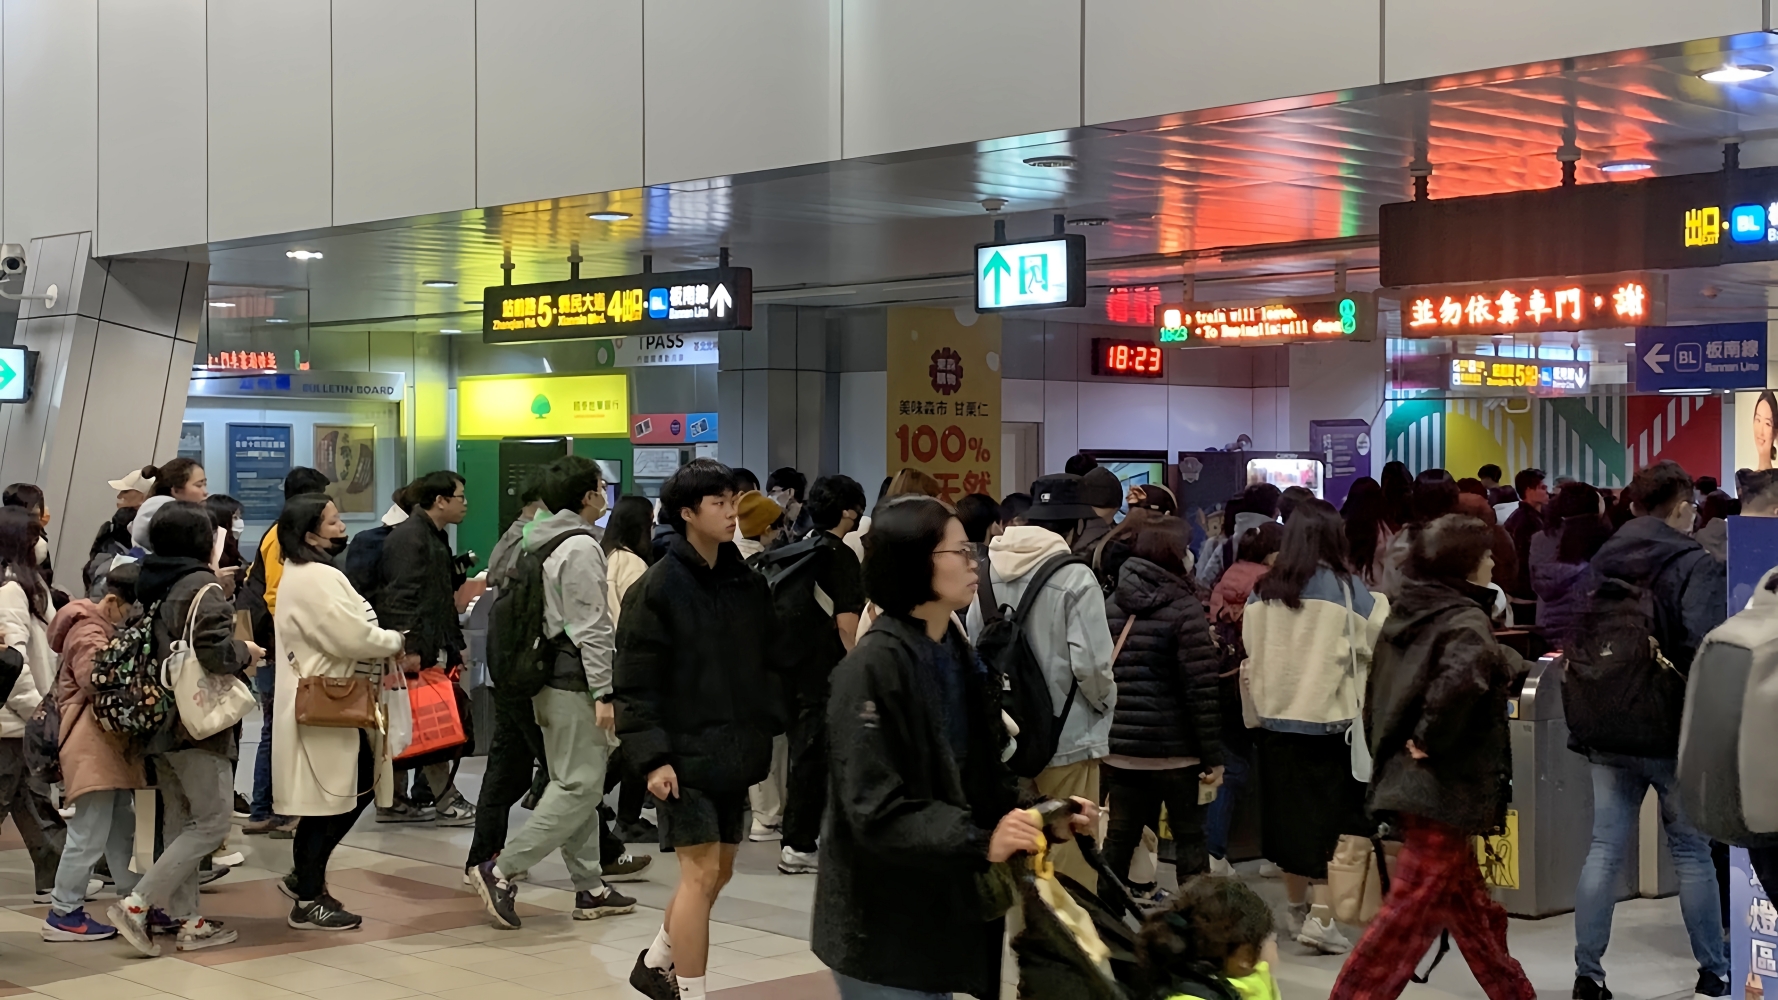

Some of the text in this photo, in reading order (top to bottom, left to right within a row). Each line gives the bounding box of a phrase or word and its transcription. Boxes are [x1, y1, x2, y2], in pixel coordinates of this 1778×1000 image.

[1737, 215, 1760, 232] BL
[537, 295, 552, 327] 5
[607, 290, 622, 322] 4
[1109, 345, 1161, 371] 18:23
[1679, 350, 1697, 364] BL
[1706, 339, 1759, 358] 板南線
[302, 383, 395, 395] BULLETIN BOARD
[895, 424, 991, 463] 100%
